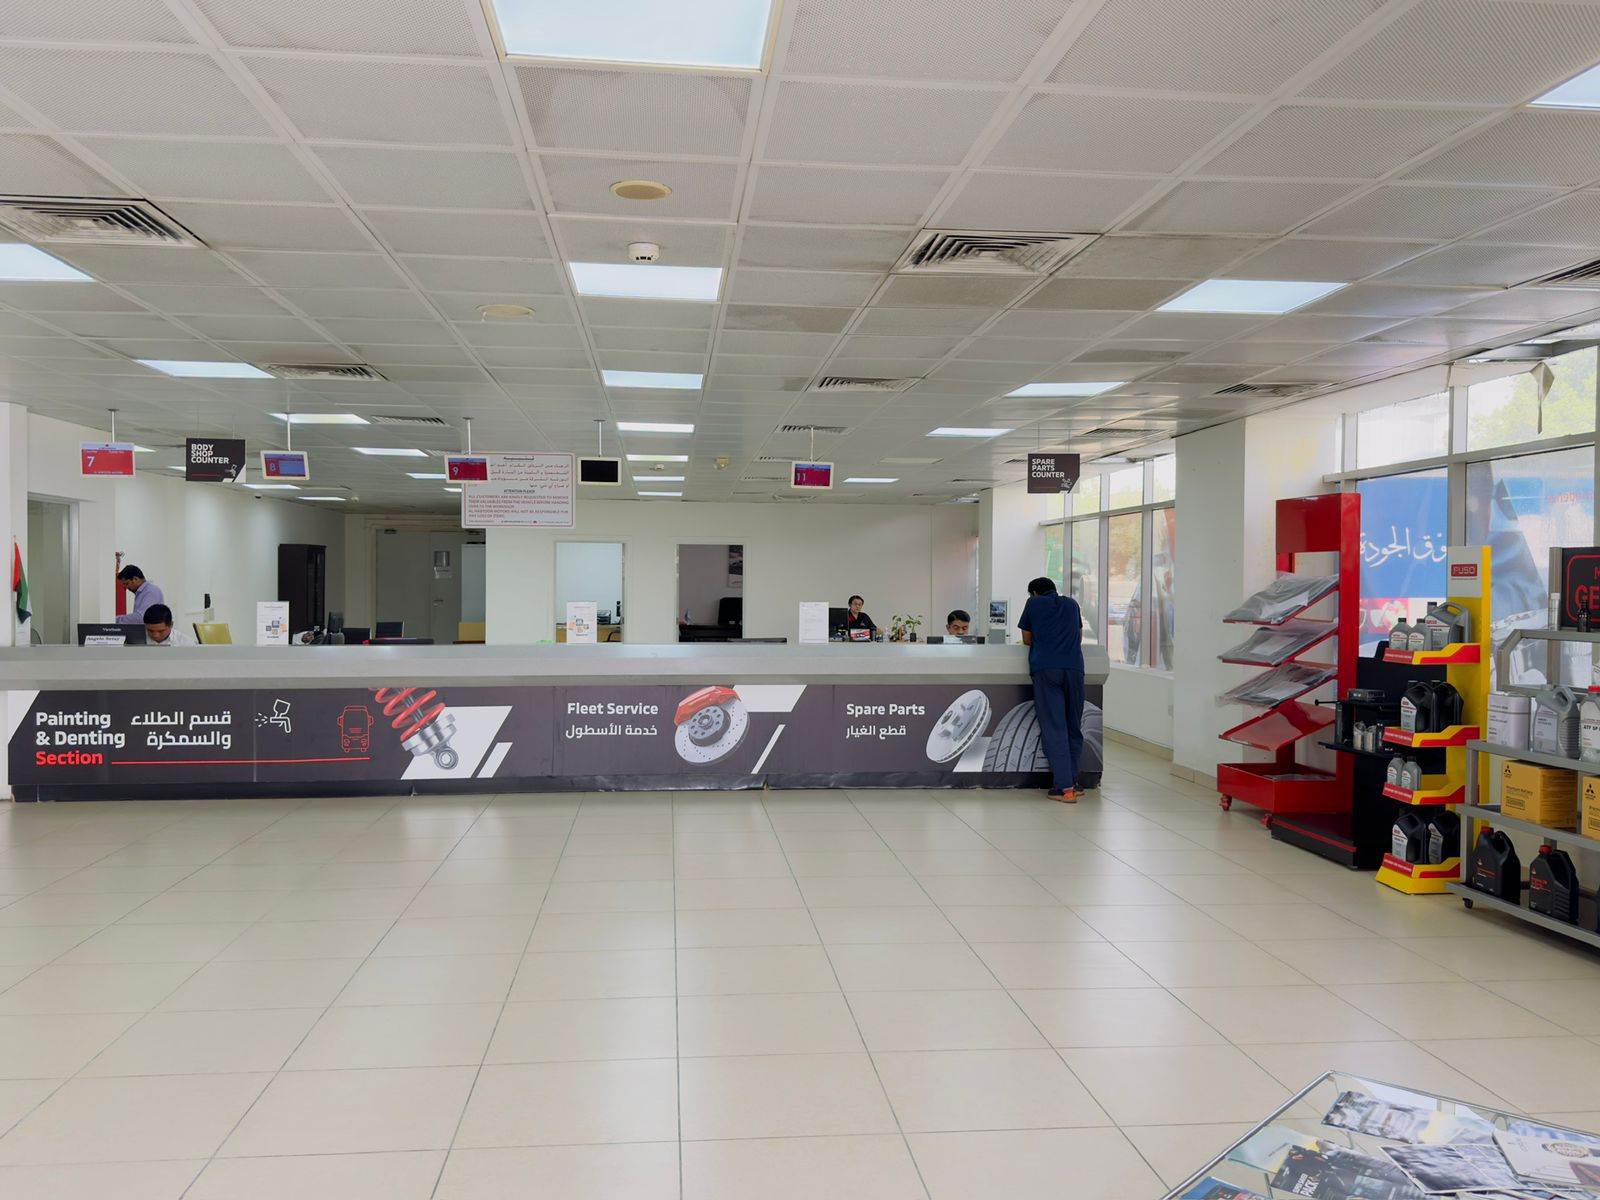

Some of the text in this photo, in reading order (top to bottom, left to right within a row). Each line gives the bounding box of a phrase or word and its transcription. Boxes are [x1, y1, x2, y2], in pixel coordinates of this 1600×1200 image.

[87, 456, 96, 467] 7
[191, 456, 230, 464] COUNTER
[452, 466, 459, 475] 9
[797, 472, 806, 481] 11
[1452, 566, 1476, 575] FUSO
[567, 702, 659, 714] Fleet Service
[846, 703, 926, 718] Spare Parts
[35, 711, 111, 729] Painting
[130, 710, 231, 730] قسم الطلاء
[565, 722, 658, 739] خدمة الأسطول
[845, 725, 907, 740] قطع الغيار
[35, 730, 126, 748] & Denting
[146, 731, 231, 750] والسمكرة
[35, 750, 103, 765] Section
